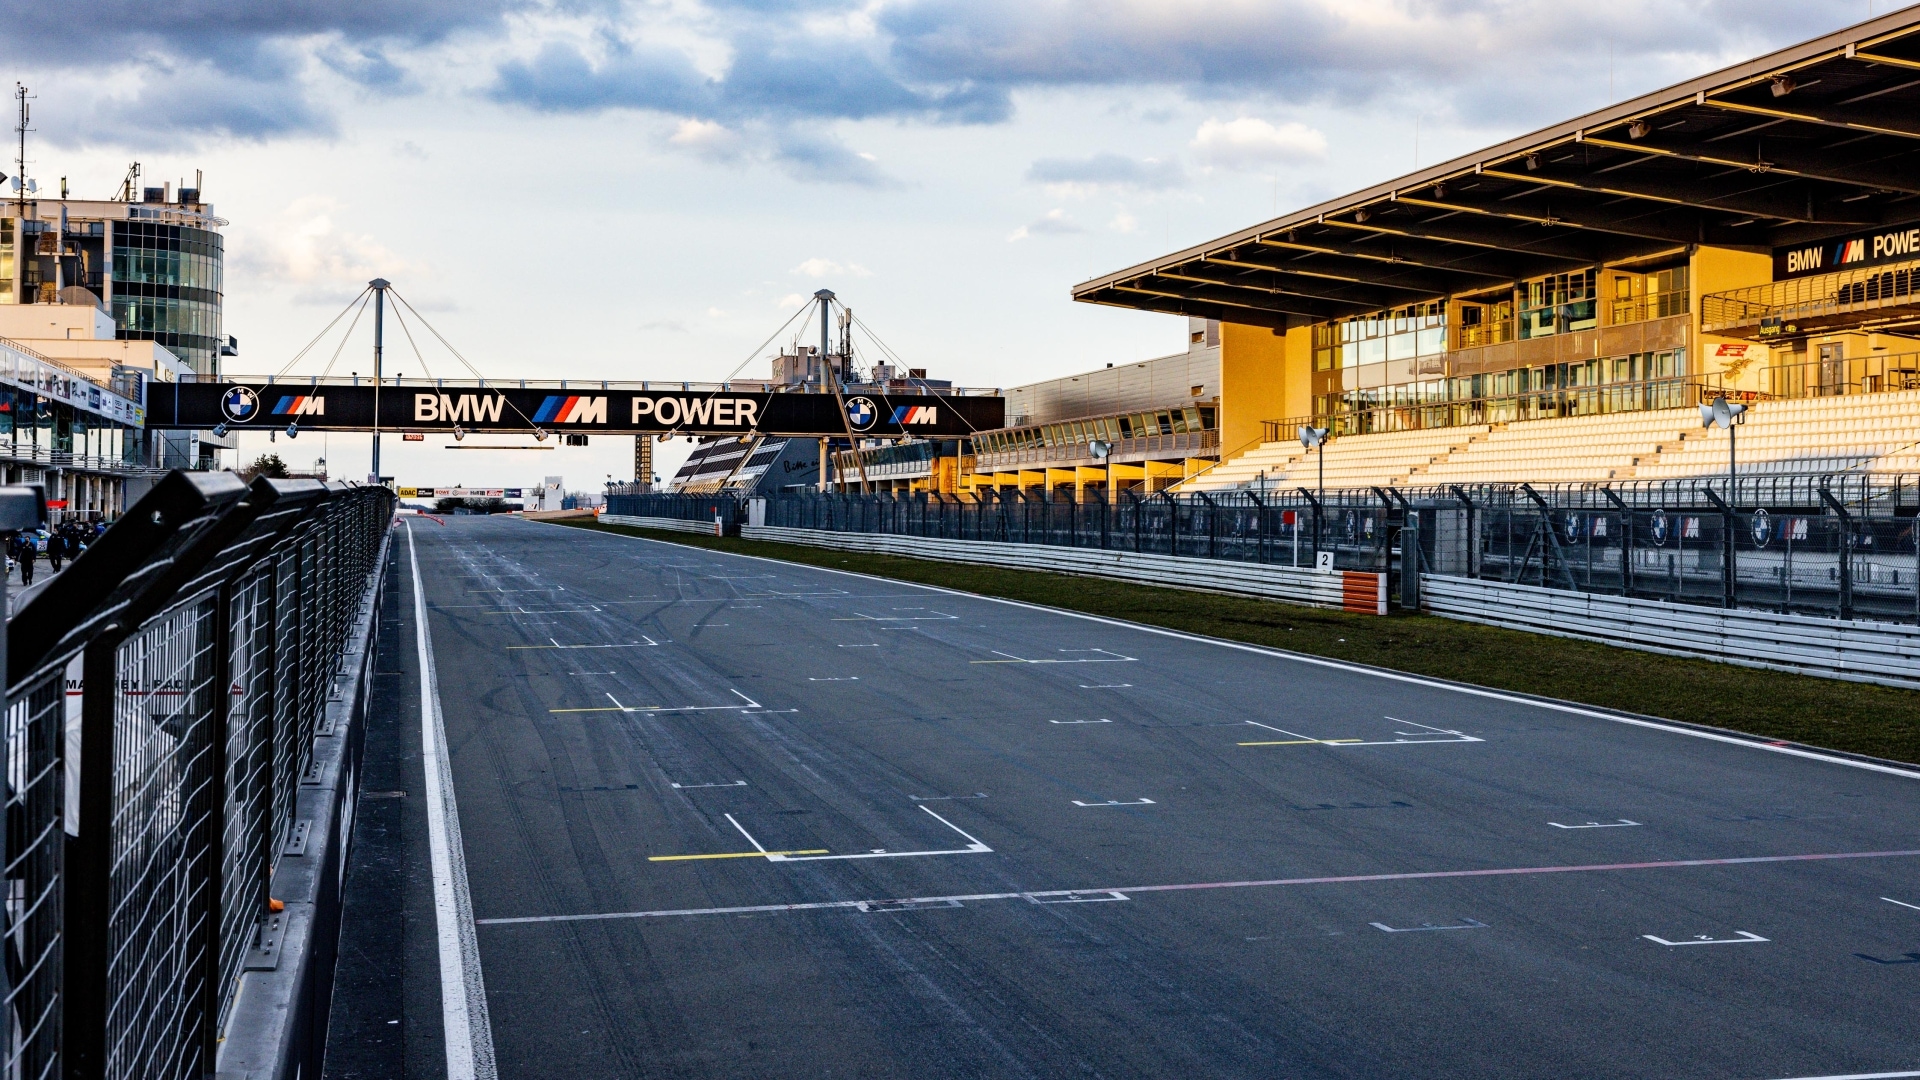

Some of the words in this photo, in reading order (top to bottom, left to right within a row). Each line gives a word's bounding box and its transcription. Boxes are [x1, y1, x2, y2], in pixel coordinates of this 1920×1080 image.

[1787, 246, 1822, 272] BMW
[1873, 228, 1920, 258] POWE
[1759, 325, 1780, 335] Ausgang
[414, 393, 505, 422] BMW
[631, 396, 758, 426] POWER
[1321, 554, 1329, 566] 2
[66, 679, 140, 690] MAEY
